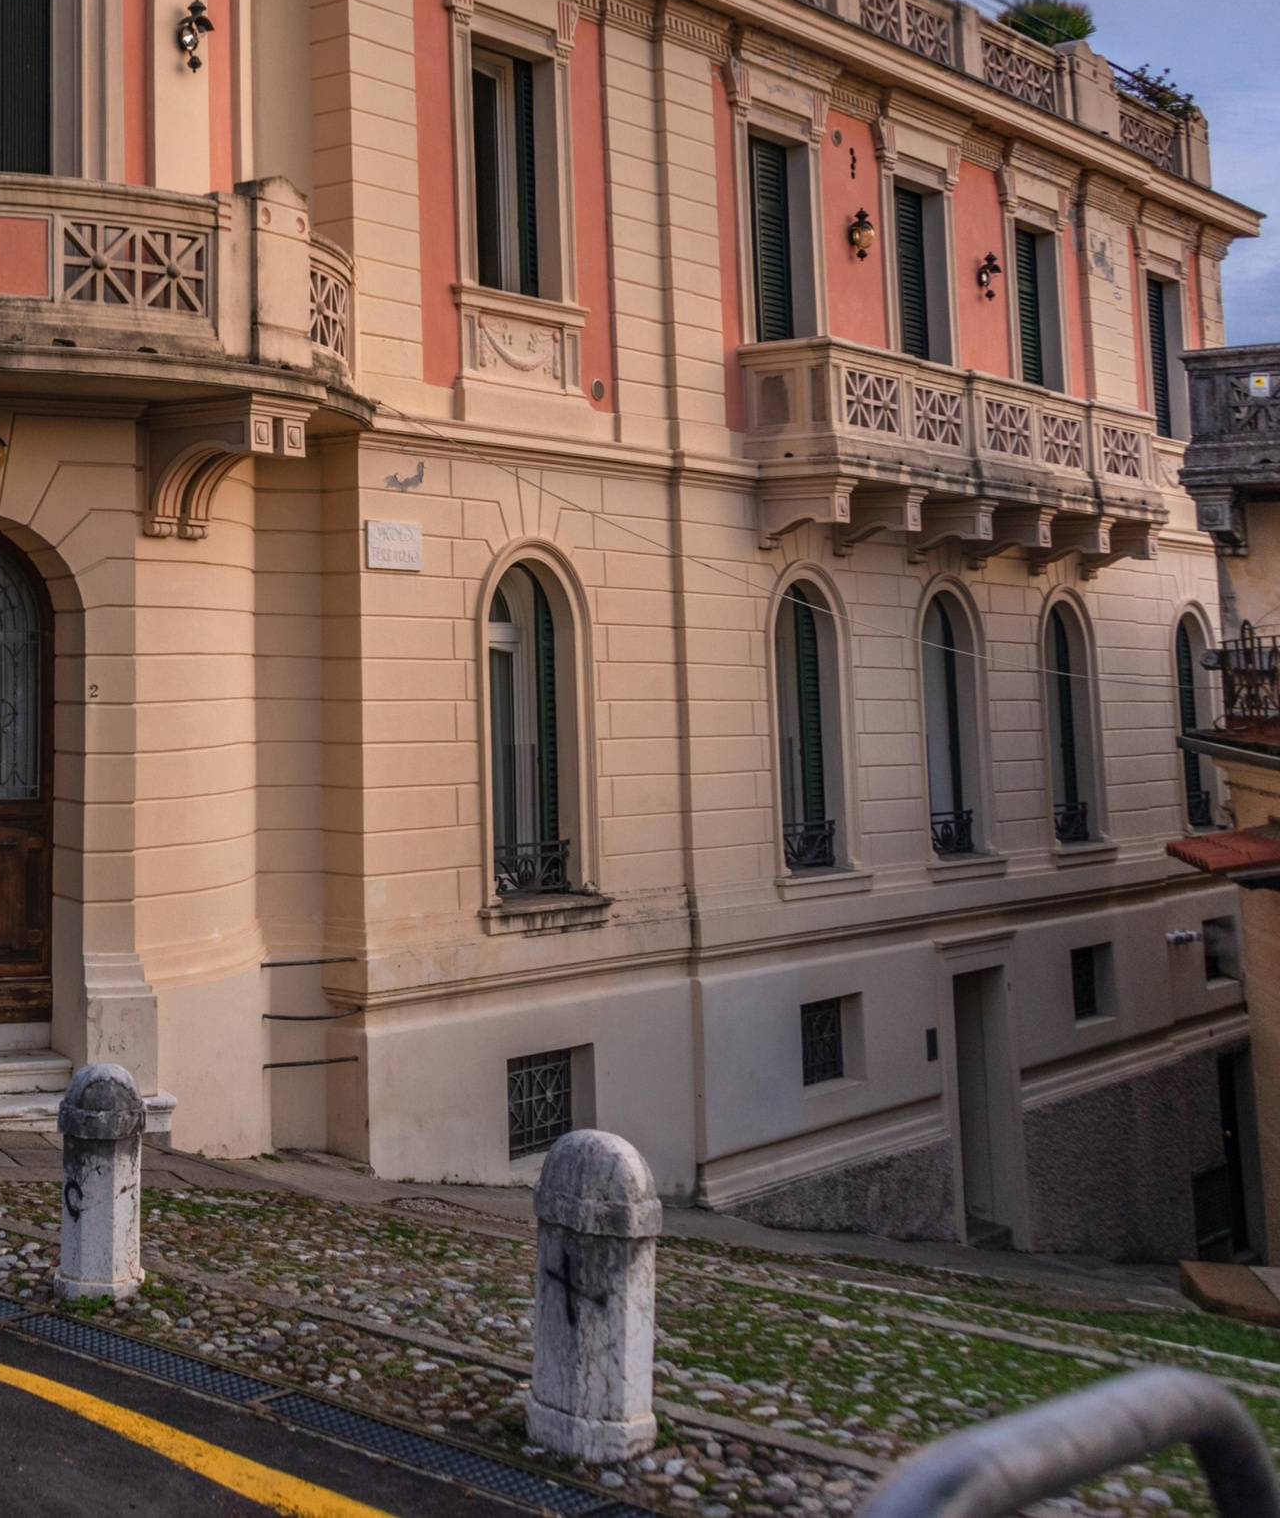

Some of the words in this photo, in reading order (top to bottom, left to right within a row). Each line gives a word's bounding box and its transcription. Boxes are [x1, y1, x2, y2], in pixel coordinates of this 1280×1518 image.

[376, 526, 414, 543] VICOLO
[370, 546, 420, 564] TERRAGLIO
[89, 684, 99, 698] 2
